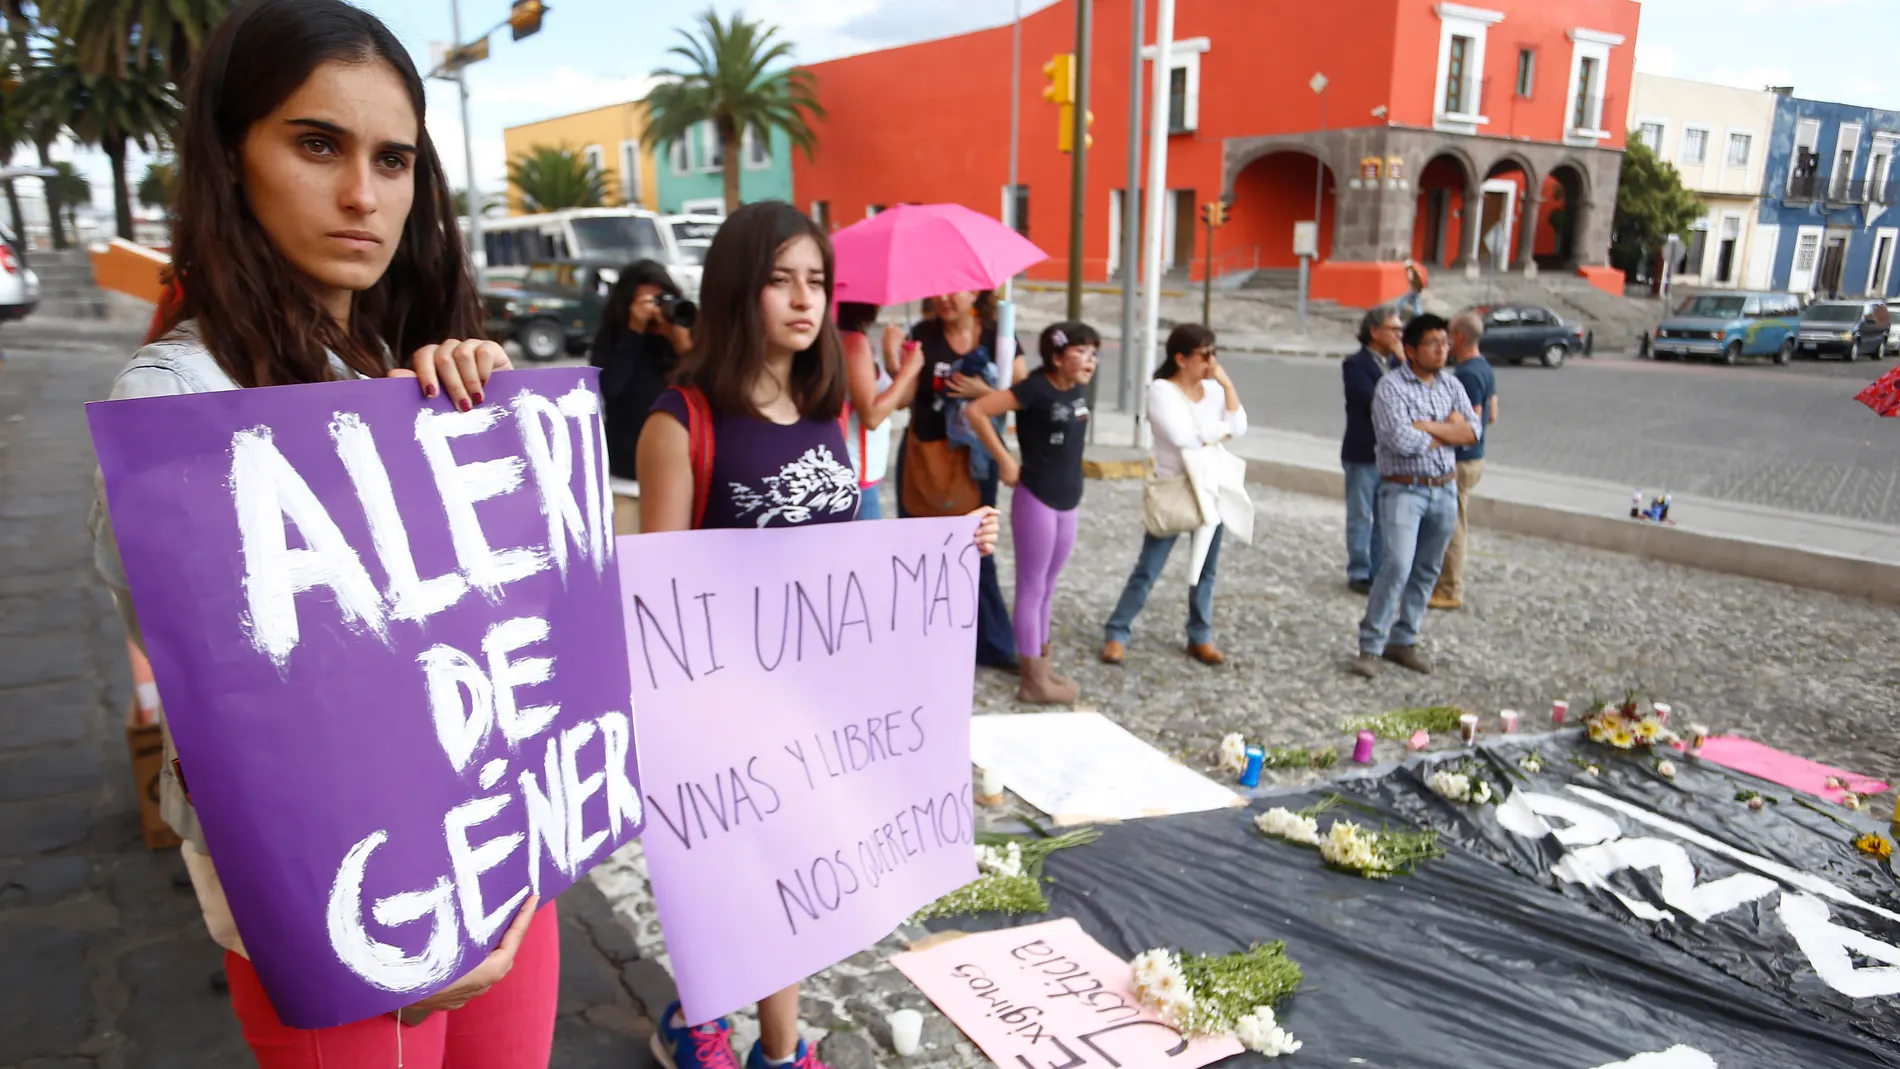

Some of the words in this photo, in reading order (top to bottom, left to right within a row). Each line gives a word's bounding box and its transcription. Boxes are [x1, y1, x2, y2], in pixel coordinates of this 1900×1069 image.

[633, 578, 724, 689] NI
[754, 571, 873, 672] UNA
[890, 532, 976, 636] MÁS
[416, 616, 561, 775] DE
[646, 756, 781, 850] VIVAS
[784, 740, 814, 789] Y
[814, 706, 924, 778] LIBRES
[776, 849, 858, 935] NOS
[858, 783, 973, 888] QUEREMOS
[1010, 939, 1188, 1068] Justicia
